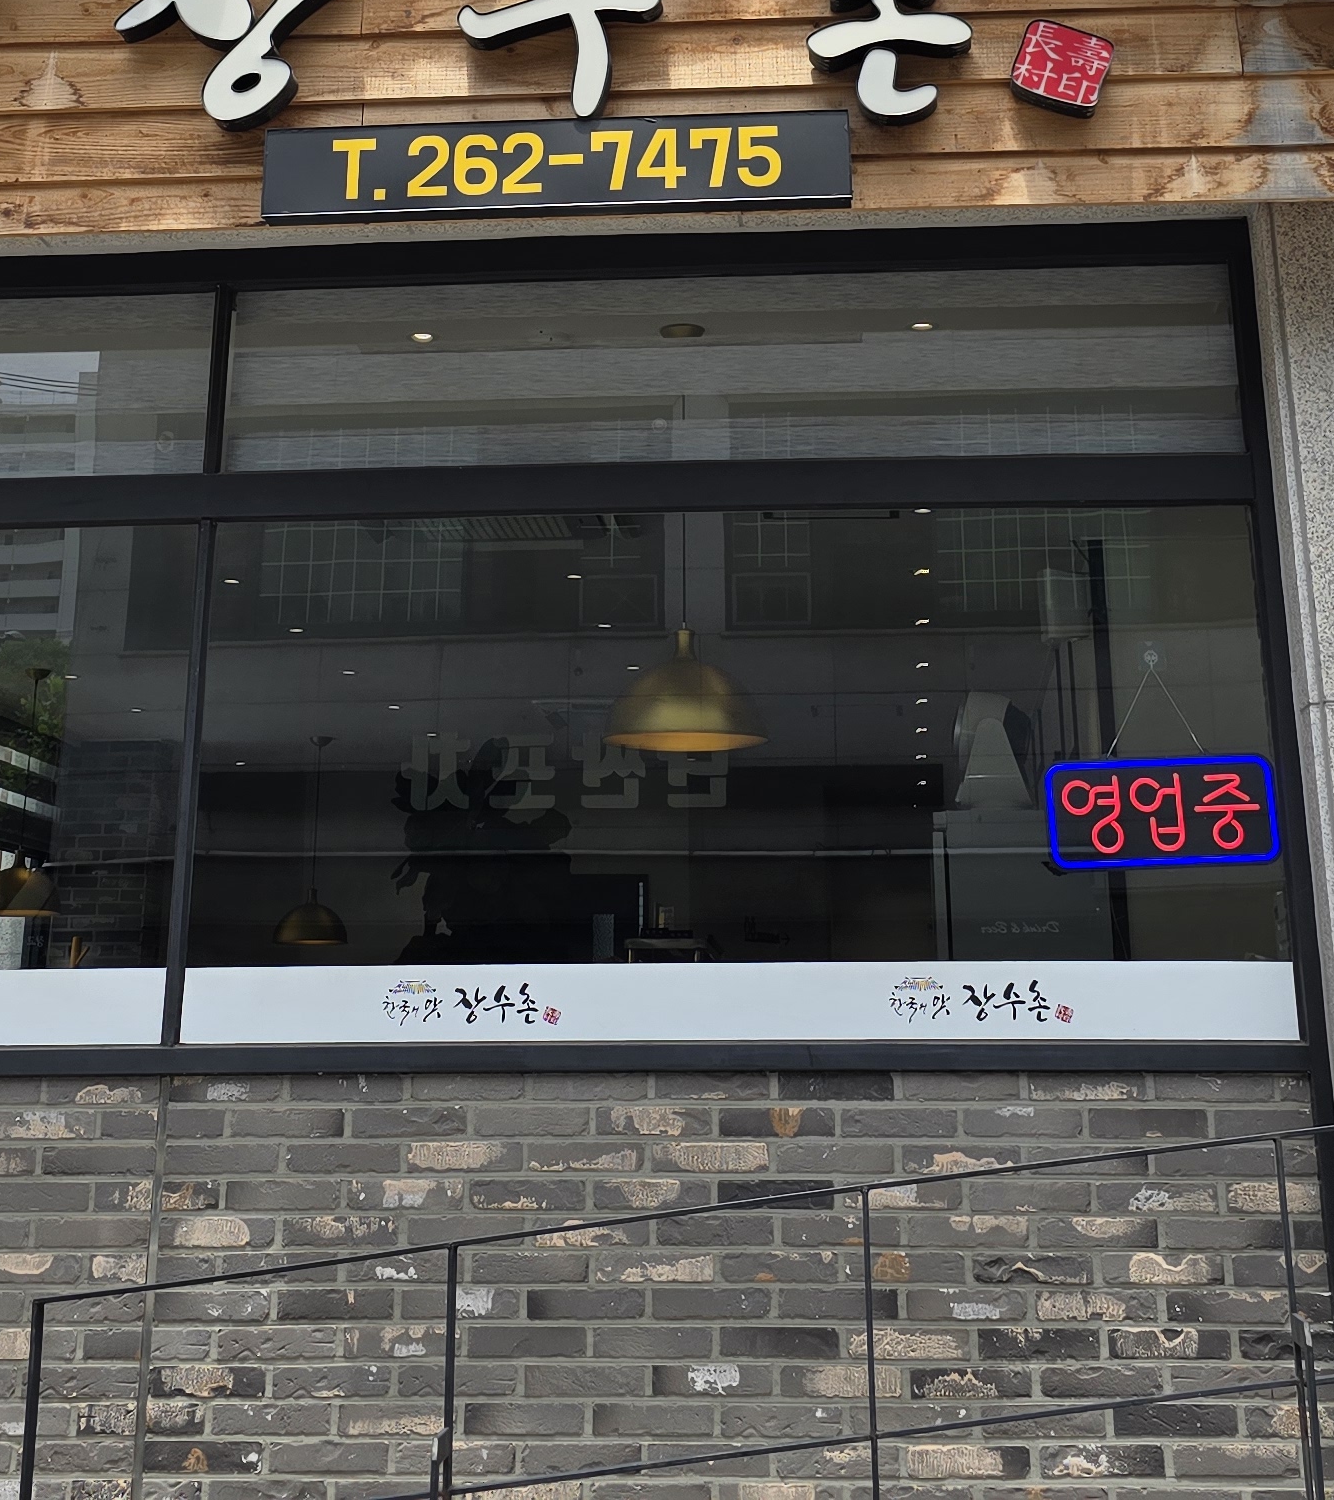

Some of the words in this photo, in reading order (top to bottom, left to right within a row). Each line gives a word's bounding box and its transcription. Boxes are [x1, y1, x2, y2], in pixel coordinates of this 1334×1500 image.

[332, 138, 385, 202] T.
[407, 127, 783, 198] 262-7475
[1061, 772, 1261, 854] 영업중
[422, 996, 444, 1023] 맛
[452, 982, 539, 1024] 장수촌
[931, 993, 951, 1020] 맛
[961, 979, 1051, 1022] 장수촌
